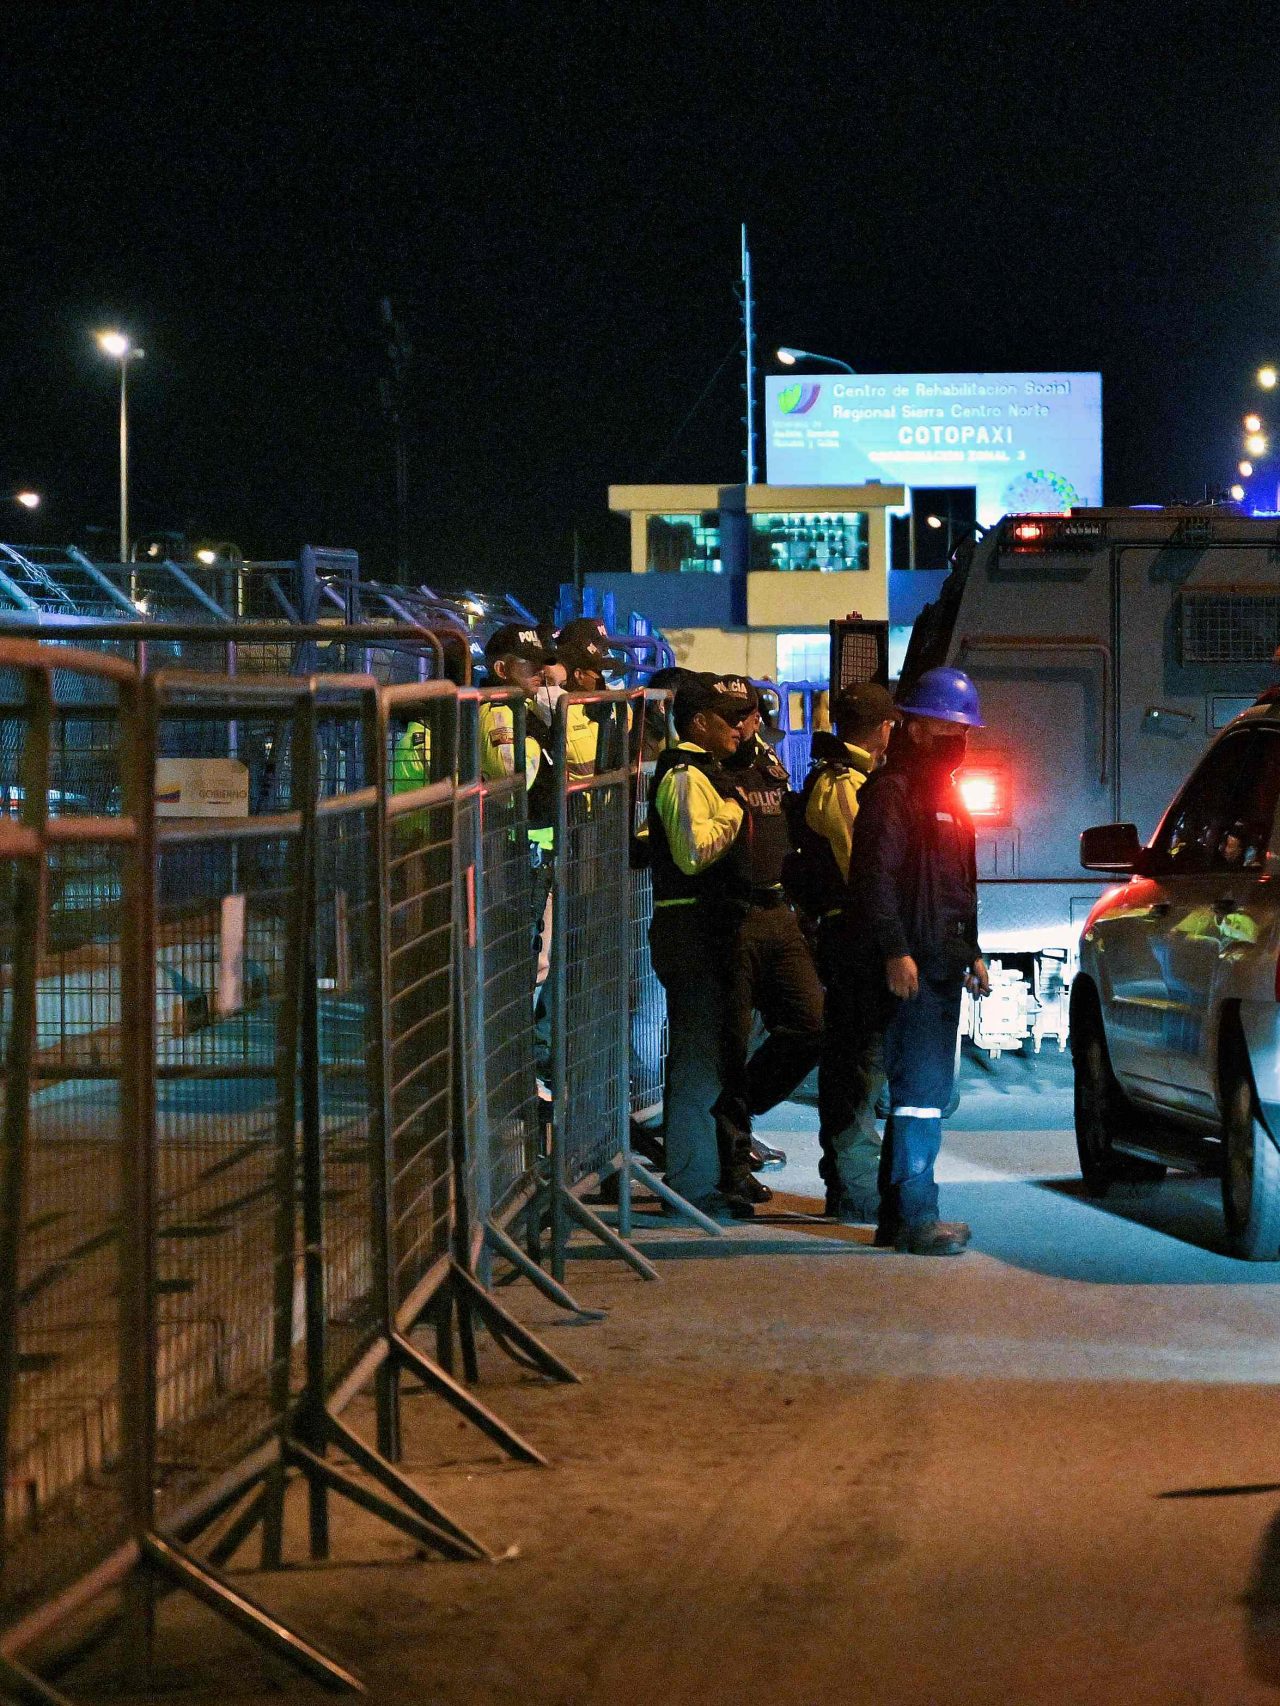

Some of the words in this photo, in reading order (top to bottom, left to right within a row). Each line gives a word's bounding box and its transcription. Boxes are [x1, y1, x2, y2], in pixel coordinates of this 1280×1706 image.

[832, 383, 886, 398] Centro
[892, 384, 909, 397] de
[1024, 379, 1072, 396] Social
[832, 404, 897, 421] Regional
[902, 404, 945, 418] Sierra
[951, 403, 1001, 418] Centro
[1008, 402, 1050, 417] Norte
[898, 425, 1013, 445] COTOPAXI
